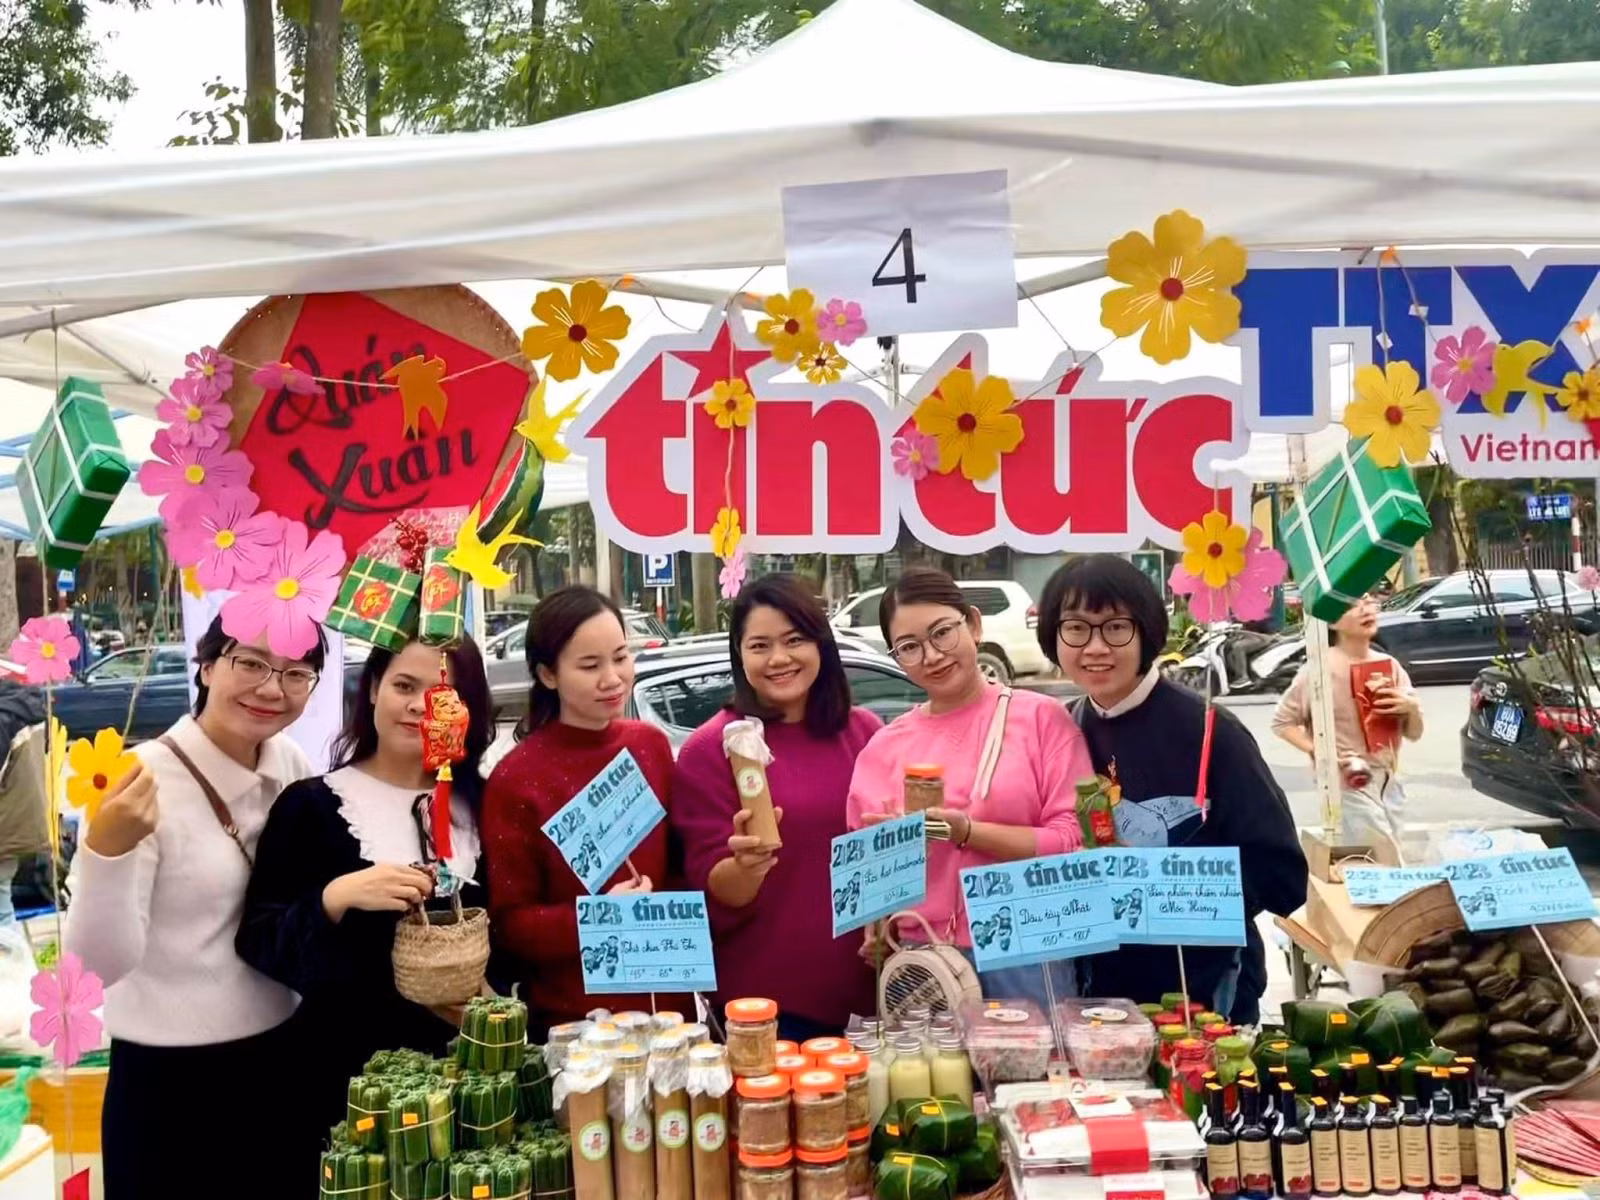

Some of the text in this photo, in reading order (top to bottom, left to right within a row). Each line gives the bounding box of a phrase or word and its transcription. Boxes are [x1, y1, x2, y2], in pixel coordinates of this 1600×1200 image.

[872, 228, 926, 303] 4
[584, 320, 881, 537] tin
[649, 554, 668, 577] P
[873, 826, 895, 852] tin
[1023, 861, 1059, 888] tin
[1160, 852, 1194, 876] tin
[1499, 857, 1533, 875] tin
[632, 896, 665, 921] tin
